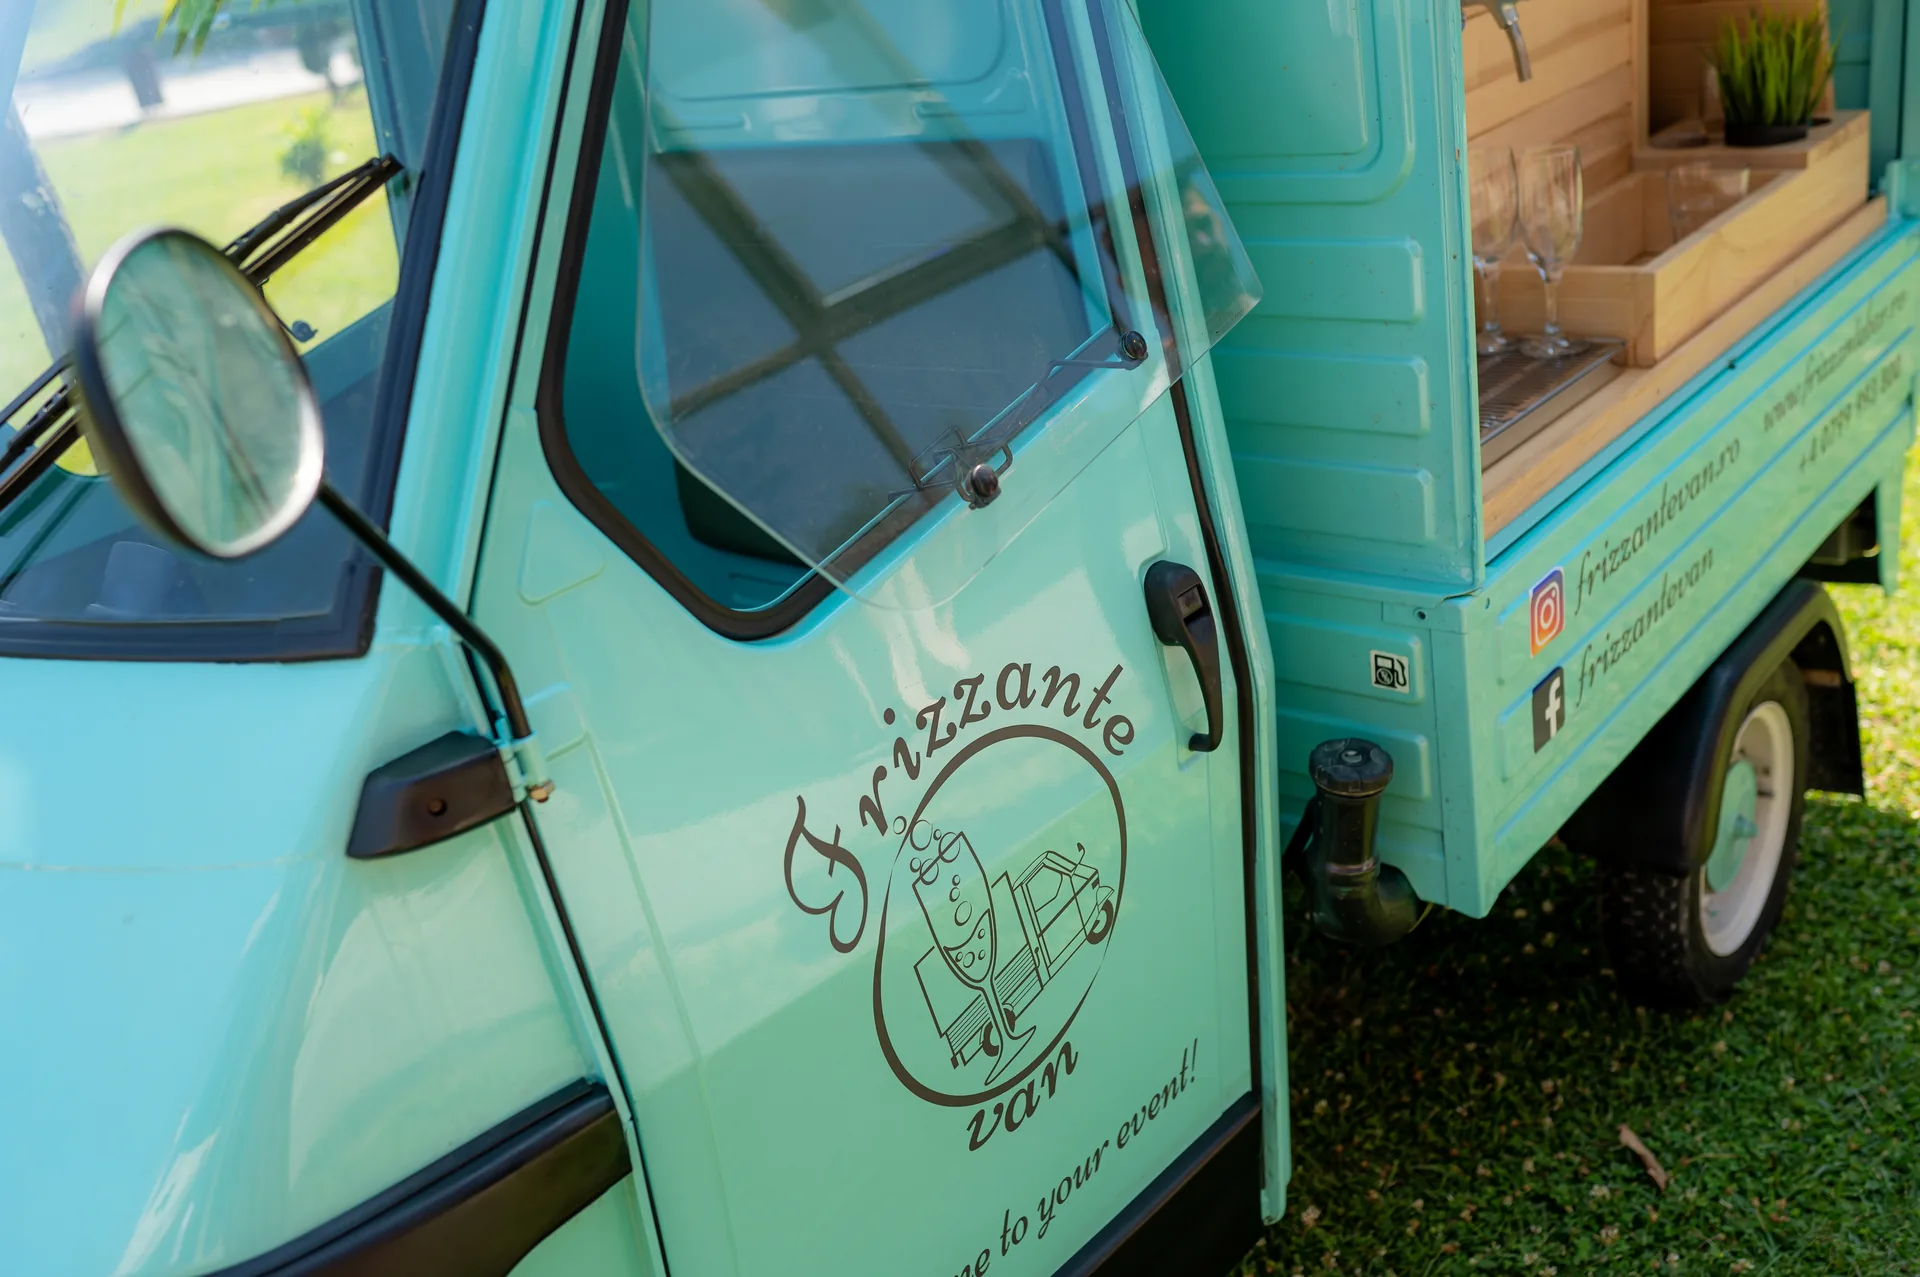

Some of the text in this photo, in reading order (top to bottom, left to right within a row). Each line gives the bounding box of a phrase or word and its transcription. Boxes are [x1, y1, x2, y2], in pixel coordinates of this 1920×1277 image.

[1574, 438, 1741, 616] frizzantevan.ro
[1575, 547, 1715, 708] frizzantevan
[783, 662, 1135, 954] Frizzante
[966, 1040, 1079, 1152] van
[1000, 1208, 1029, 1257] to
[1037, 1140, 1109, 1240] your
[1117, 1037, 1198, 1150] event!
